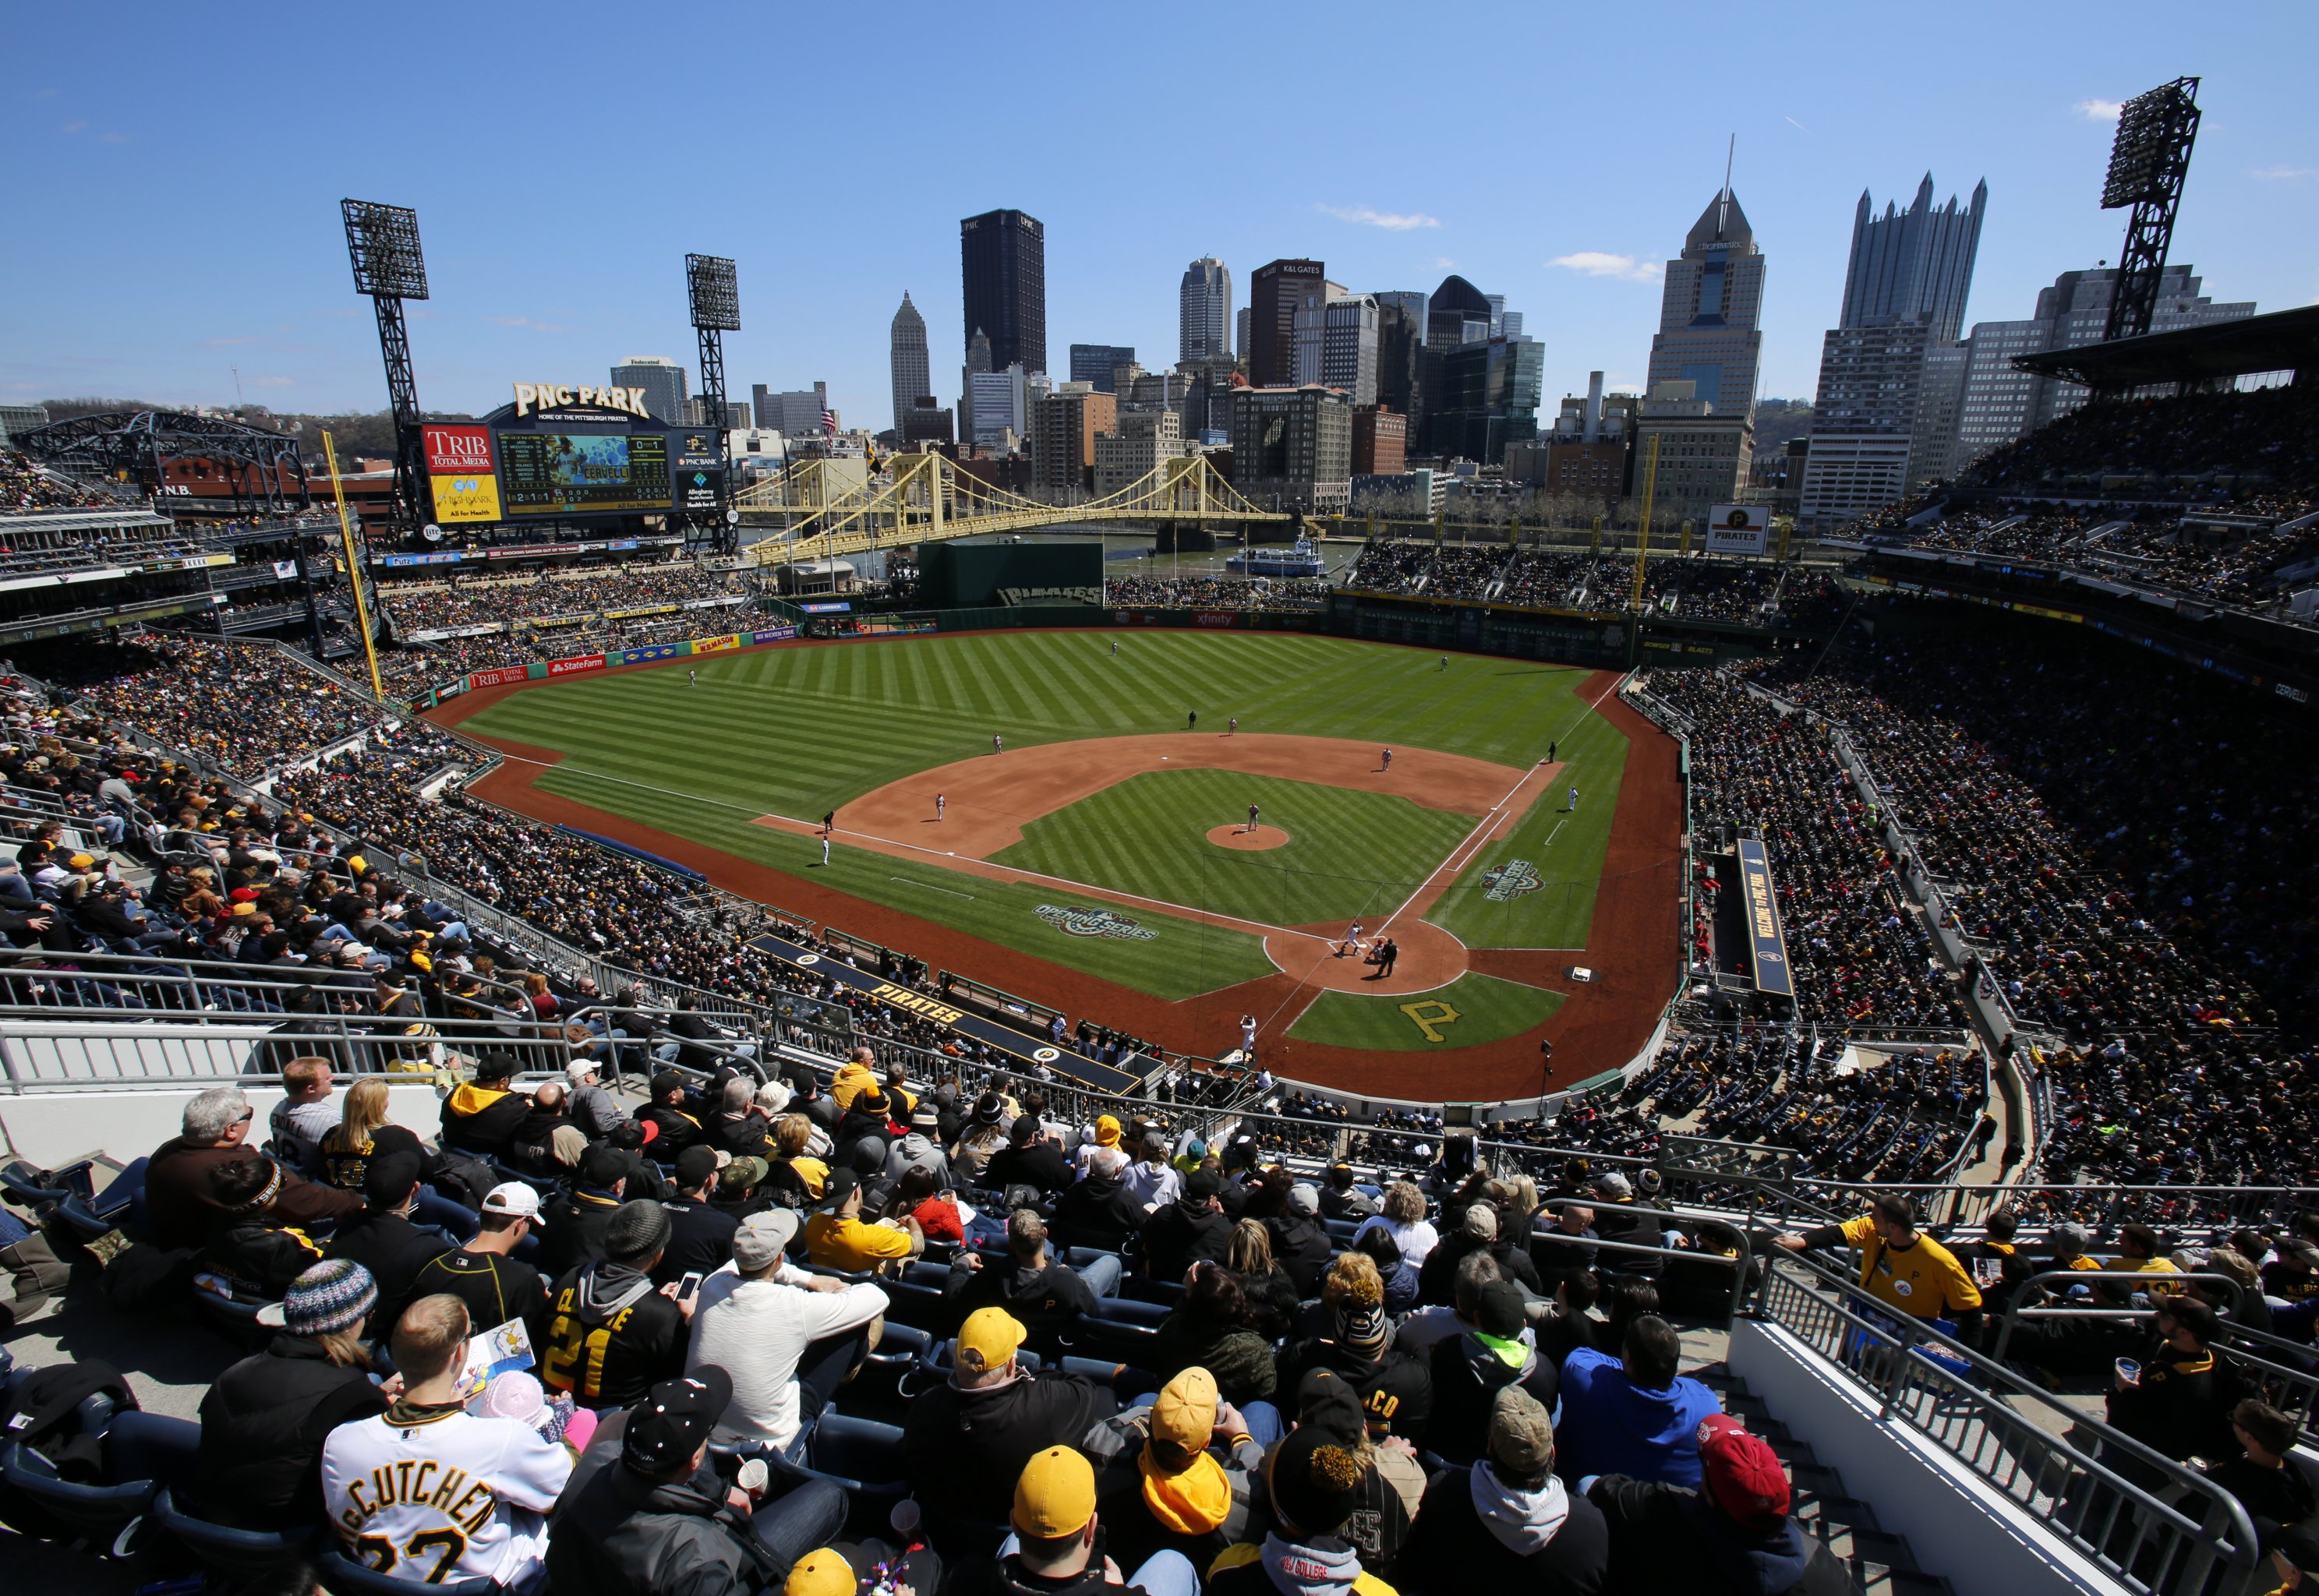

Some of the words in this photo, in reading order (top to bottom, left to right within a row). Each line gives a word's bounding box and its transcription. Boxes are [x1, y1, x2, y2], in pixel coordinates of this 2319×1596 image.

[1020, 215, 1034, 230] UPMC
[1699, 242, 1742, 250] HIGHMARK
[1297, 266, 1320, 274] GATES
[513, 382, 574, 417] PNC
[578, 386, 650, 419] PARK
[427, 431, 487, 455] TRIB
[431, 456, 462, 465] TOTAL
[462, 457, 490, 465] MEDIA
[584, 467, 629, 479] CERVELLI
[1734, 514, 1744, 526] P
[426, 528, 440, 537] Lite
[1715, 531, 1757, 541] PIRATES
[1005, 587, 1102, 605] PIRATES
[1197, 613, 1232, 626] xfinity
[1365, 612, 1408, 621] NATIONAL
[23, 631, 33, 640] 17
[36, 629, 58, 637] STRIKE
[58, 625, 69, 634] 25
[91, 620, 101, 628] 42
[1493, 626, 1543, 635] AMERICAN
[1546, 630, 1585, 640] LEAGUE
[1687, 646, 1714, 655] BLASTS
[501, 668, 523, 676] TOTAL
[471, 673, 500, 687] TRIB
[2275, 682, 2308, 703] CERVELLI
[1749, 873, 1766, 888] PARK
[1752, 887, 1768, 901] PNC
[1034, 905, 1101, 927] OPENING
[1101, 920, 1158, 940] SERIES
[1755, 906, 1775, 938] WELCOME
[871, 984, 963, 1023] PIRATES
[1398, 998, 1464, 1043] P
[765, 1134, 777, 1147] P
[758, 1185, 801, 1206] PIRATES
[1912, 1270, 1921, 1280] P
[543, 1315, 612, 1398] 21
[1295, 1559, 1328, 1580] COLLEGE
